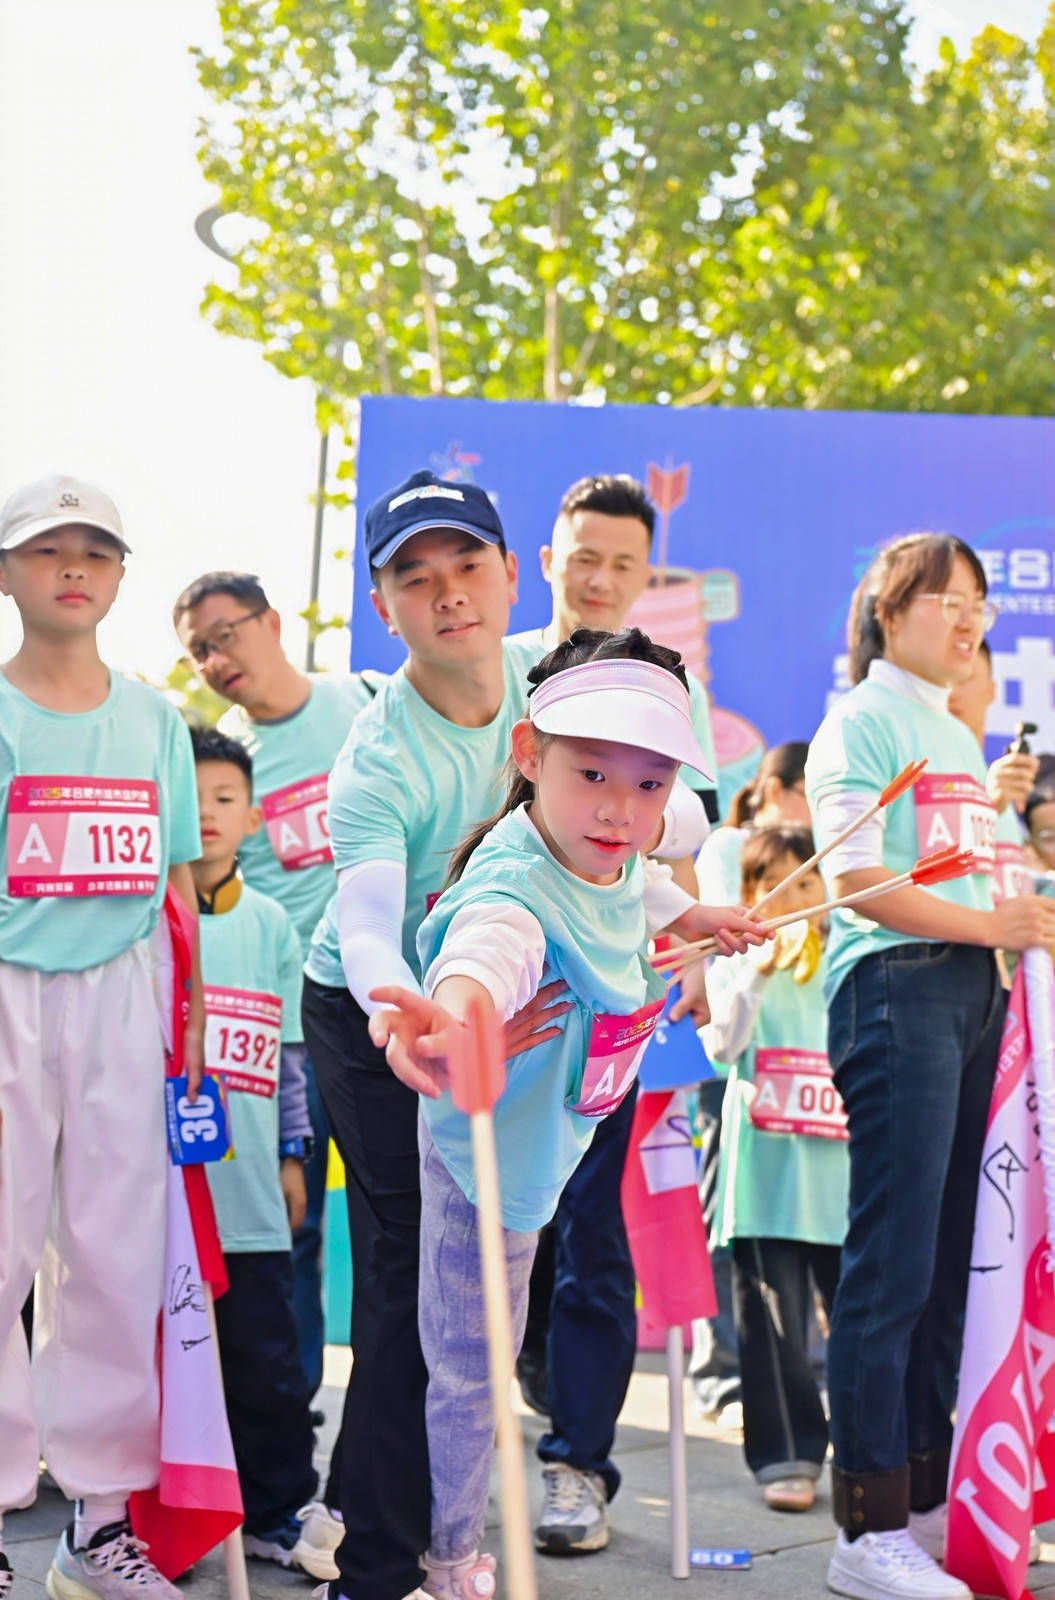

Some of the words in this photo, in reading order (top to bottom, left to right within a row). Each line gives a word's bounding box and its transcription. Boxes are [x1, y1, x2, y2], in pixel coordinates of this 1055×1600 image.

[16, 823, 53, 864] A
[88, 825, 153, 864] 1132
[281, 822, 304, 853] A
[926, 812, 954, 848] A
[219, 1027, 278, 1071] 1392
[584, 1062, 615, 1105] A
[755, 1079, 780, 1109] A
[799, 1084, 847, 1115] 00
[177, 1094, 218, 1144] 30
